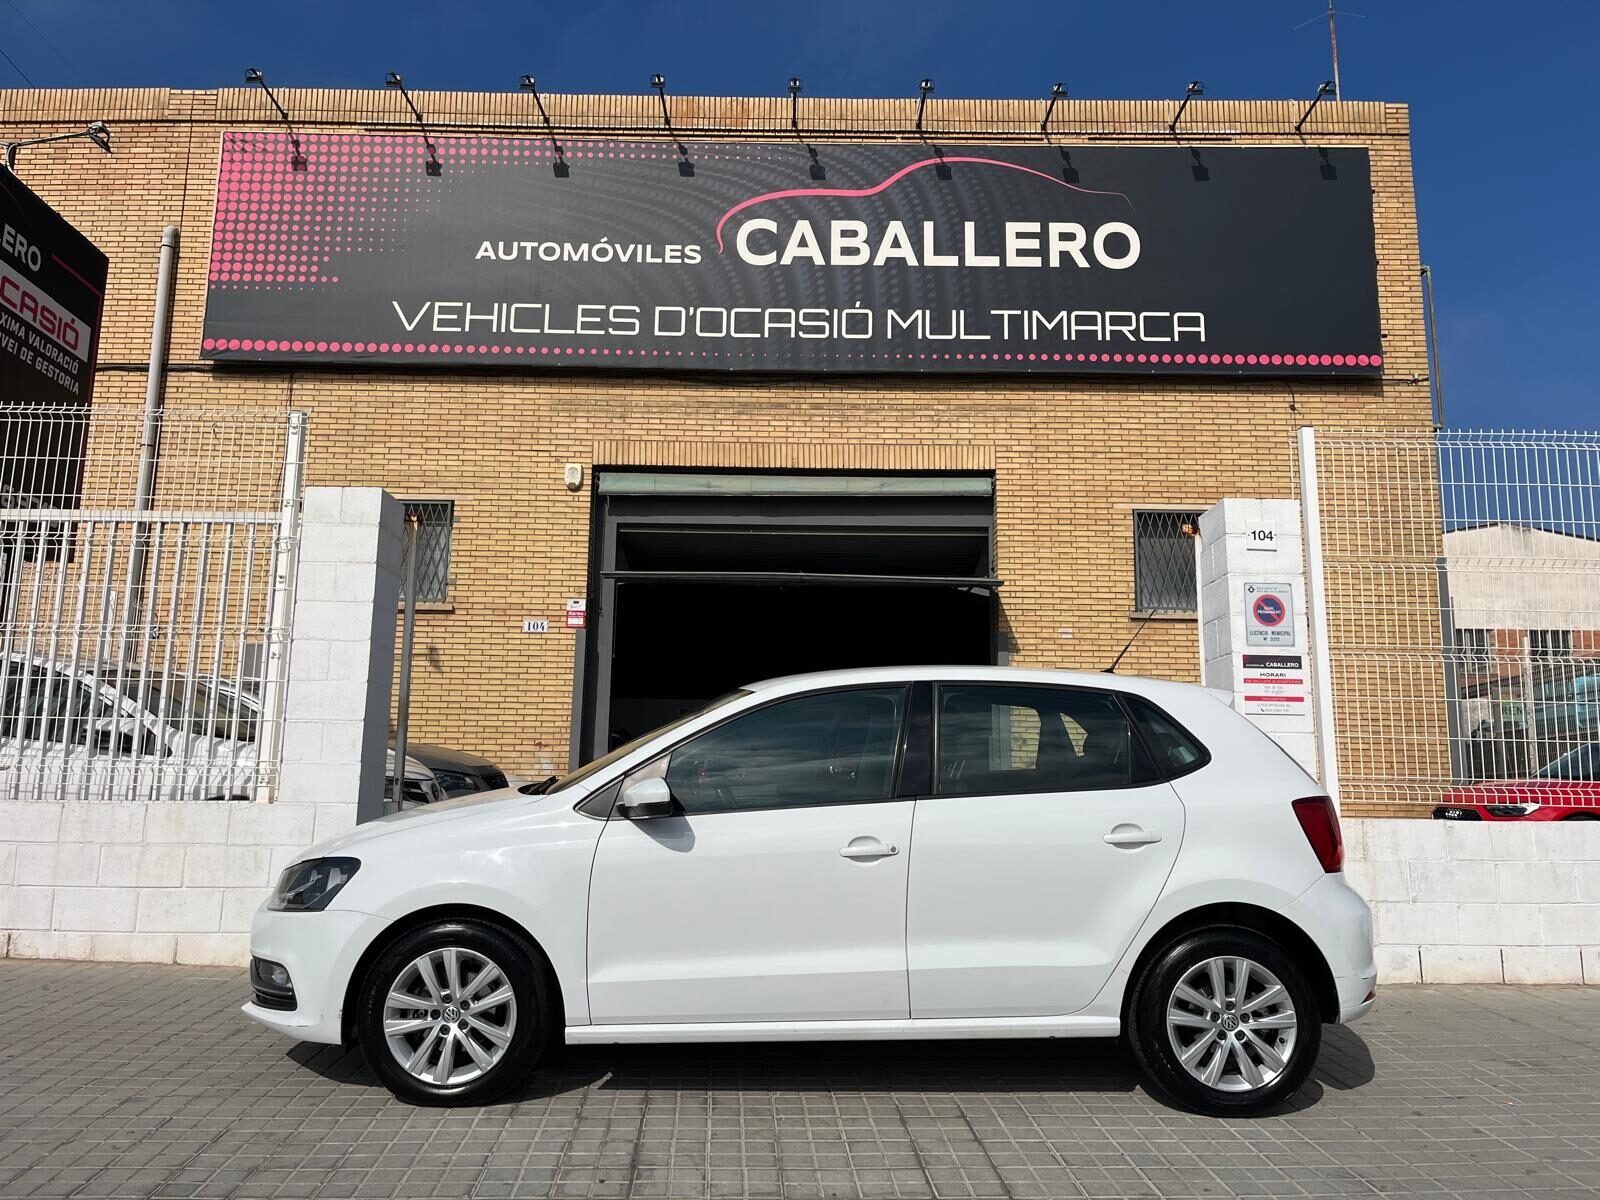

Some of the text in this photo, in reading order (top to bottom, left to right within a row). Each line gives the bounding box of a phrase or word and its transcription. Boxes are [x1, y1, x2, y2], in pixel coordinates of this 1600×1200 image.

[0, 223, 41, 271] ERO
[475, 218, 1141, 270] AUTOMÓVILES CABALLERO
[392, 300, 1206, 342] VEHICLES D'OCASIÓ MULTIMARCA
[20, 346, 34, 365] DE
[36, 356, 79, 395] GESTORIA
[29, 330, 79, 375] VALORACIÓ
[1251, 530, 1275, 541] 104
[527, 621, 545, 631] 104
